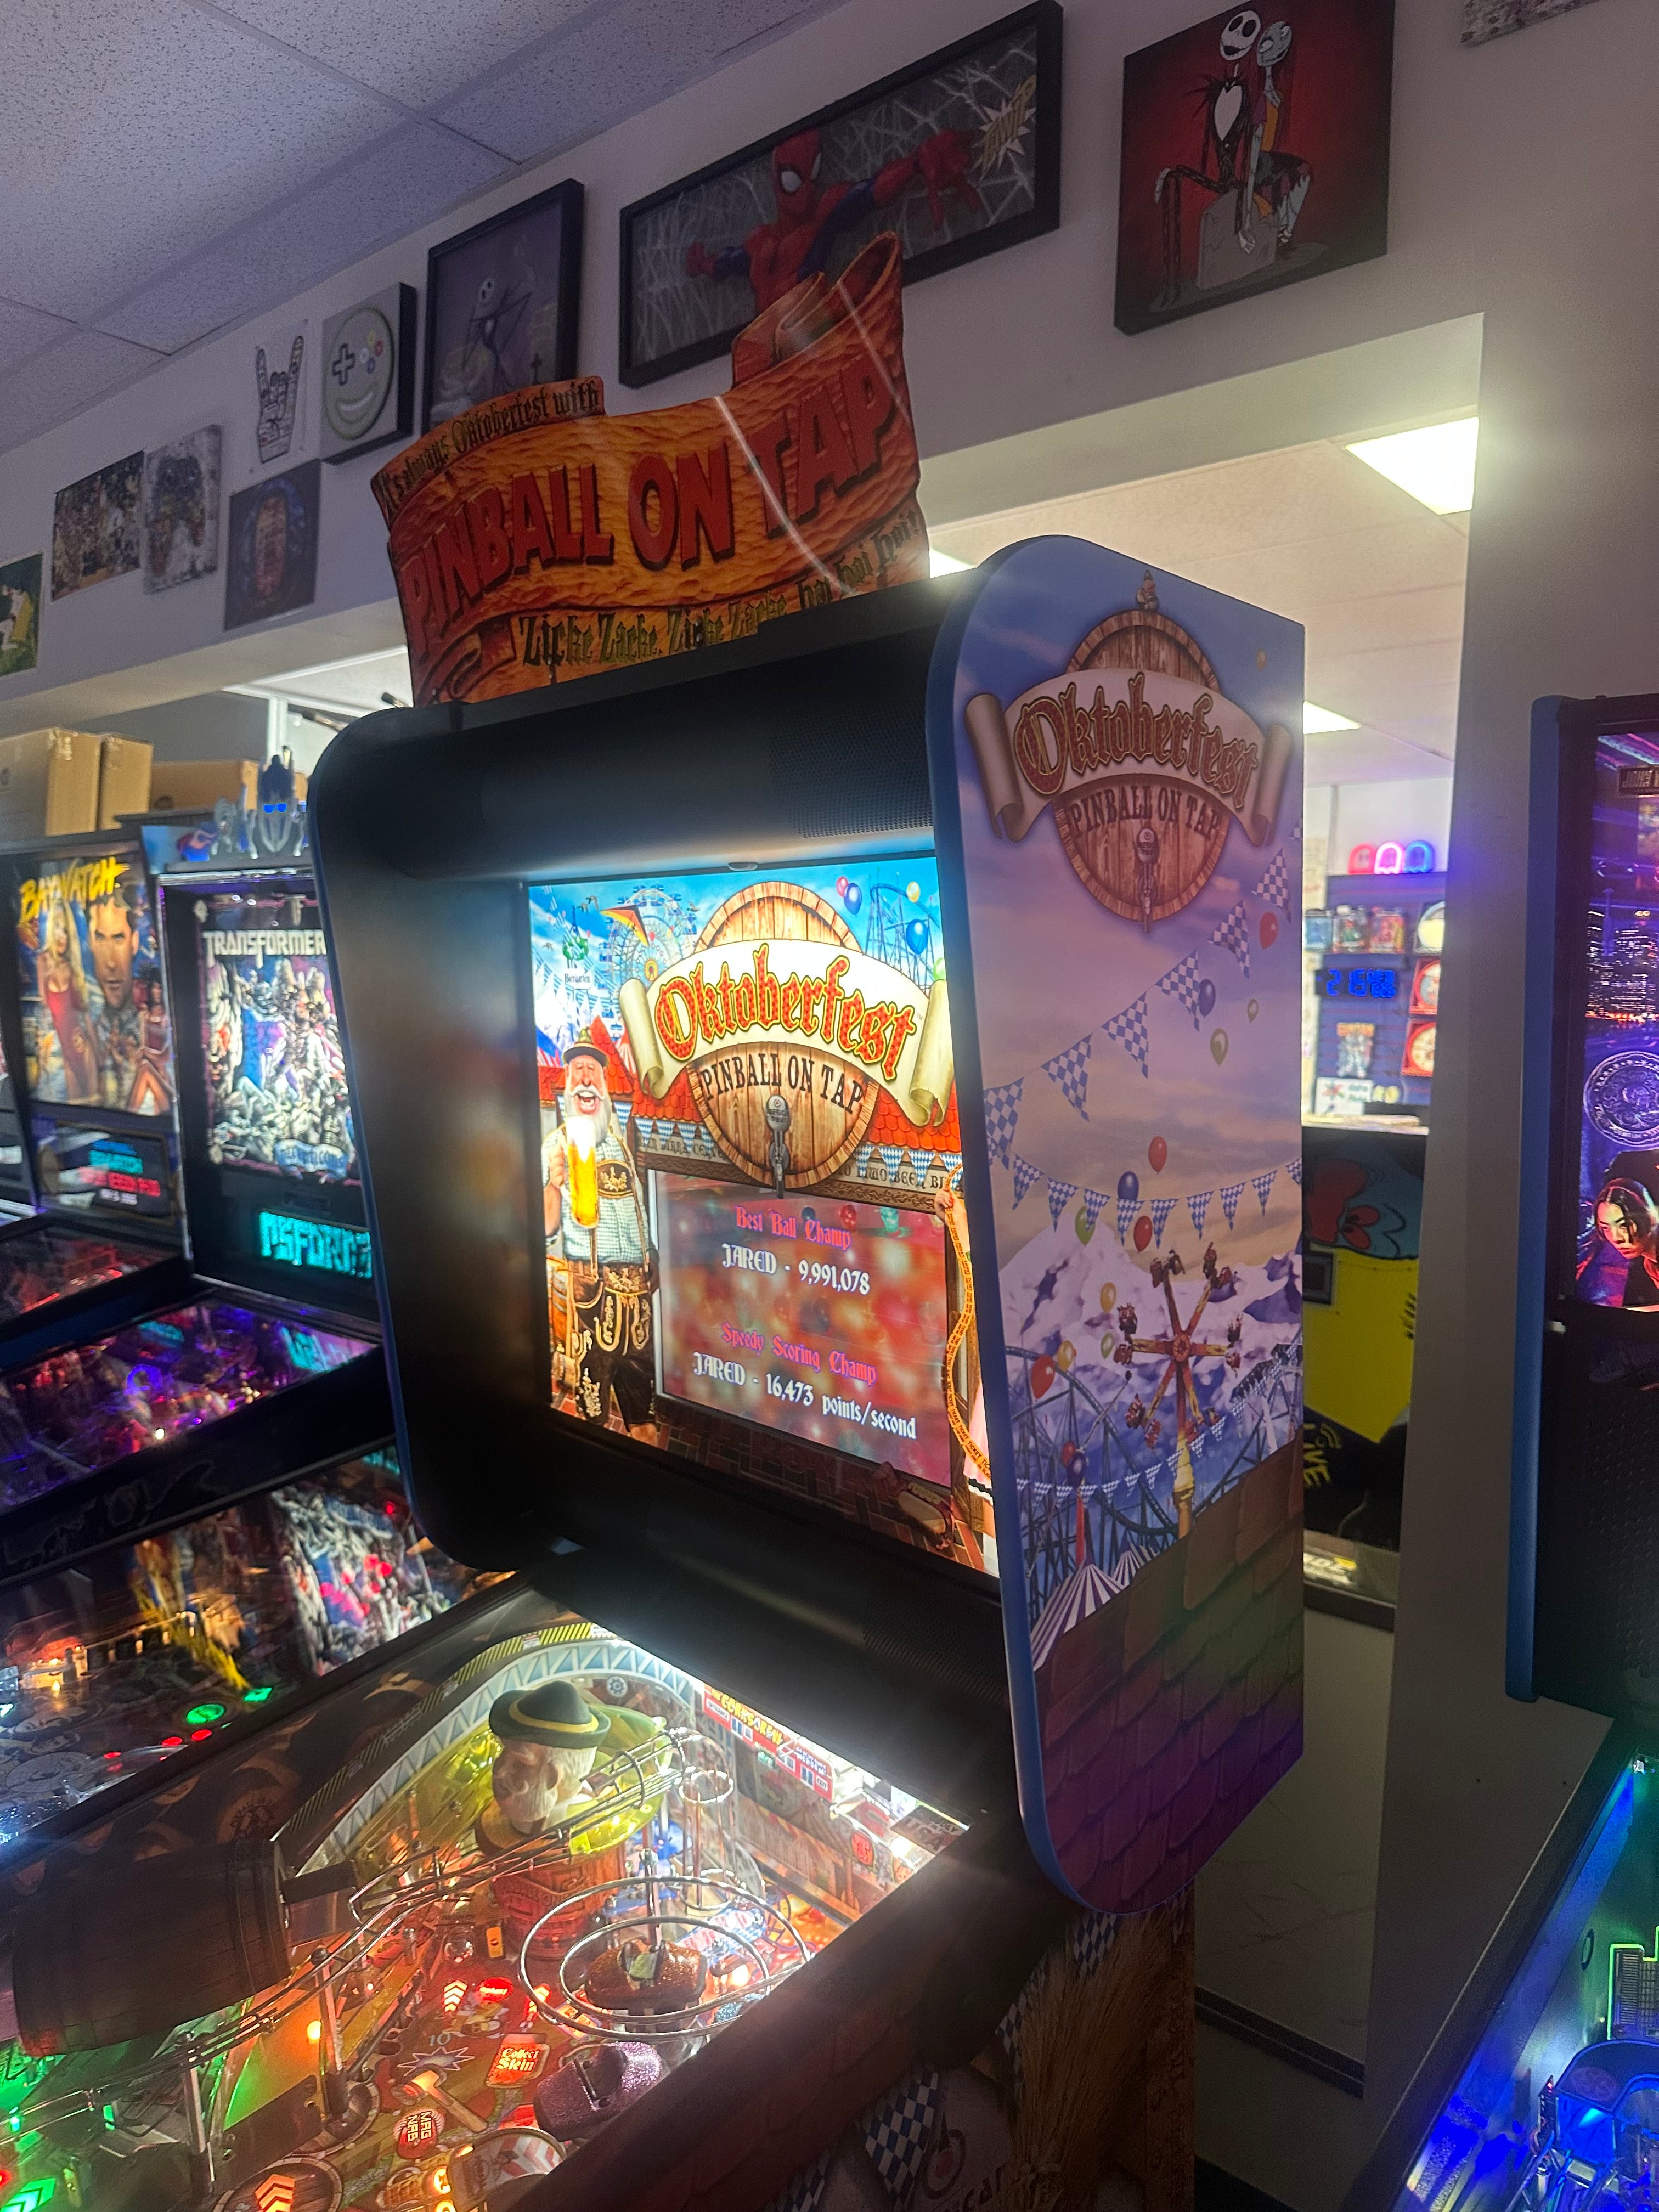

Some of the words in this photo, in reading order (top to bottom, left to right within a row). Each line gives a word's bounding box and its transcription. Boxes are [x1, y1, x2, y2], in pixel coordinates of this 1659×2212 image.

[404, 434, 450, 489] always
[452, 386, 549, 454] Oktoberfest
[552, 379, 600, 416] with
[400, 464, 614, 662] PINBALL
[628, 439, 735, 572] ON
[744, 354, 897, 539] TAP
[518, 613, 593, 667] Zicke
[1013, 672, 1258, 809] Oktoberfest
[1069, 784, 1153, 839] PINBALL
[1157, 786, 1182, 822] ON
[1187, 798, 1222, 840] TAP
[19, 856, 130, 926] BAYWATCH
[655, 943, 917, 1081] Oktoberfest
[701, 1053, 782, 1101] PINBALL
[787, 1055, 816, 1099] ON
[821, 1064, 864, 1115] TAP
[735, 1205, 763, 1234] Best
[771, 1210, 797, 1239] Ball
[805, 1216, 851, 1251] Champ
[721, 1243, 777, 1275] JARED
[798, 1260, 870, 1295] 9,991,078
[721, 1322, 764, 1356] Speedy
[772, 1335, 821, 1373] Scoring
[830, 1350, 877, 1387] Champ
[693, 1352, 746, 1386] JARED
[766, 1373, 814, 1407] 16,473
[822, 1393, 917, 1441] points/second
[957, 1424, 969, 1440] TICKET
[968, 1441, 982, 1458] TICKET
[429, 2033, 451, 2047] 10
[495, 2057, 535, 2072] Stein
[501, 2047, 539, 2059] Collect
[407, 2114, 419, 2142] NAB
[420, 2111, 432, 2140] MAG
